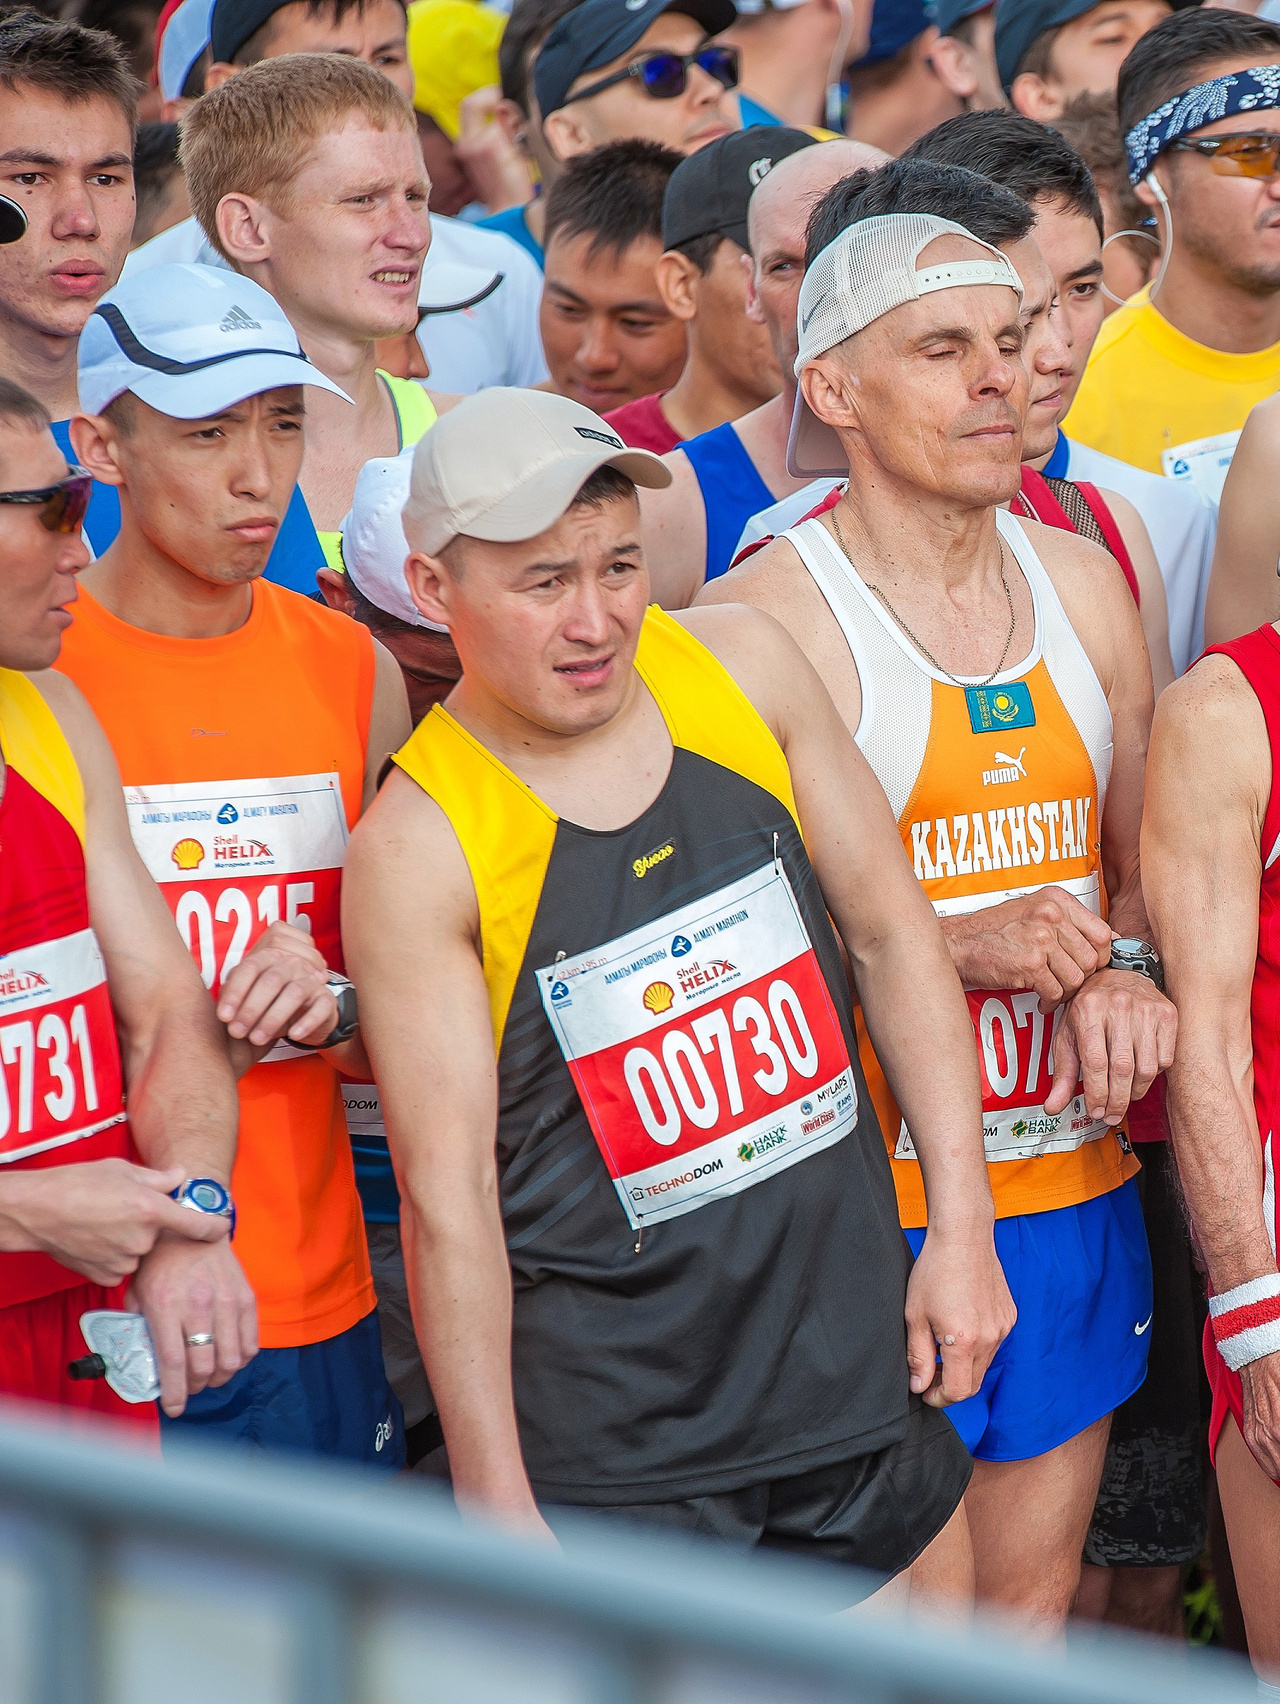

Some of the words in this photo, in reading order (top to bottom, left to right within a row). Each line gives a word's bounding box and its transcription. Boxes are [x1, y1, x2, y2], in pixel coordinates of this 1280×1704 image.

[220, 320, 262, 332] adidas
[982, 766, 1020, 786] PUMA
[214, 834, 238, 846] Shell
[910, 796, 1091, 880] KAZAKHSTAN
[214, 842, 271, 860] HELIX
[676, 962, 700, 980] Shell
[680, 960, 735, 993] HELIX
[979, 990, 1065, 1098] 07
[624, 979, 819, 1146] 00730
[817, 1076, 848, 1102] MYLAPS
[1028, 1116, 1062, 1127] HALYK
[1028, 1126, 1058, 1134] BANK
[753, 1124, 788, 1147] HALYK
[756, 1134, 788, 1154] BANK
[644, 1158, 724, 1197] TECHNODOM
